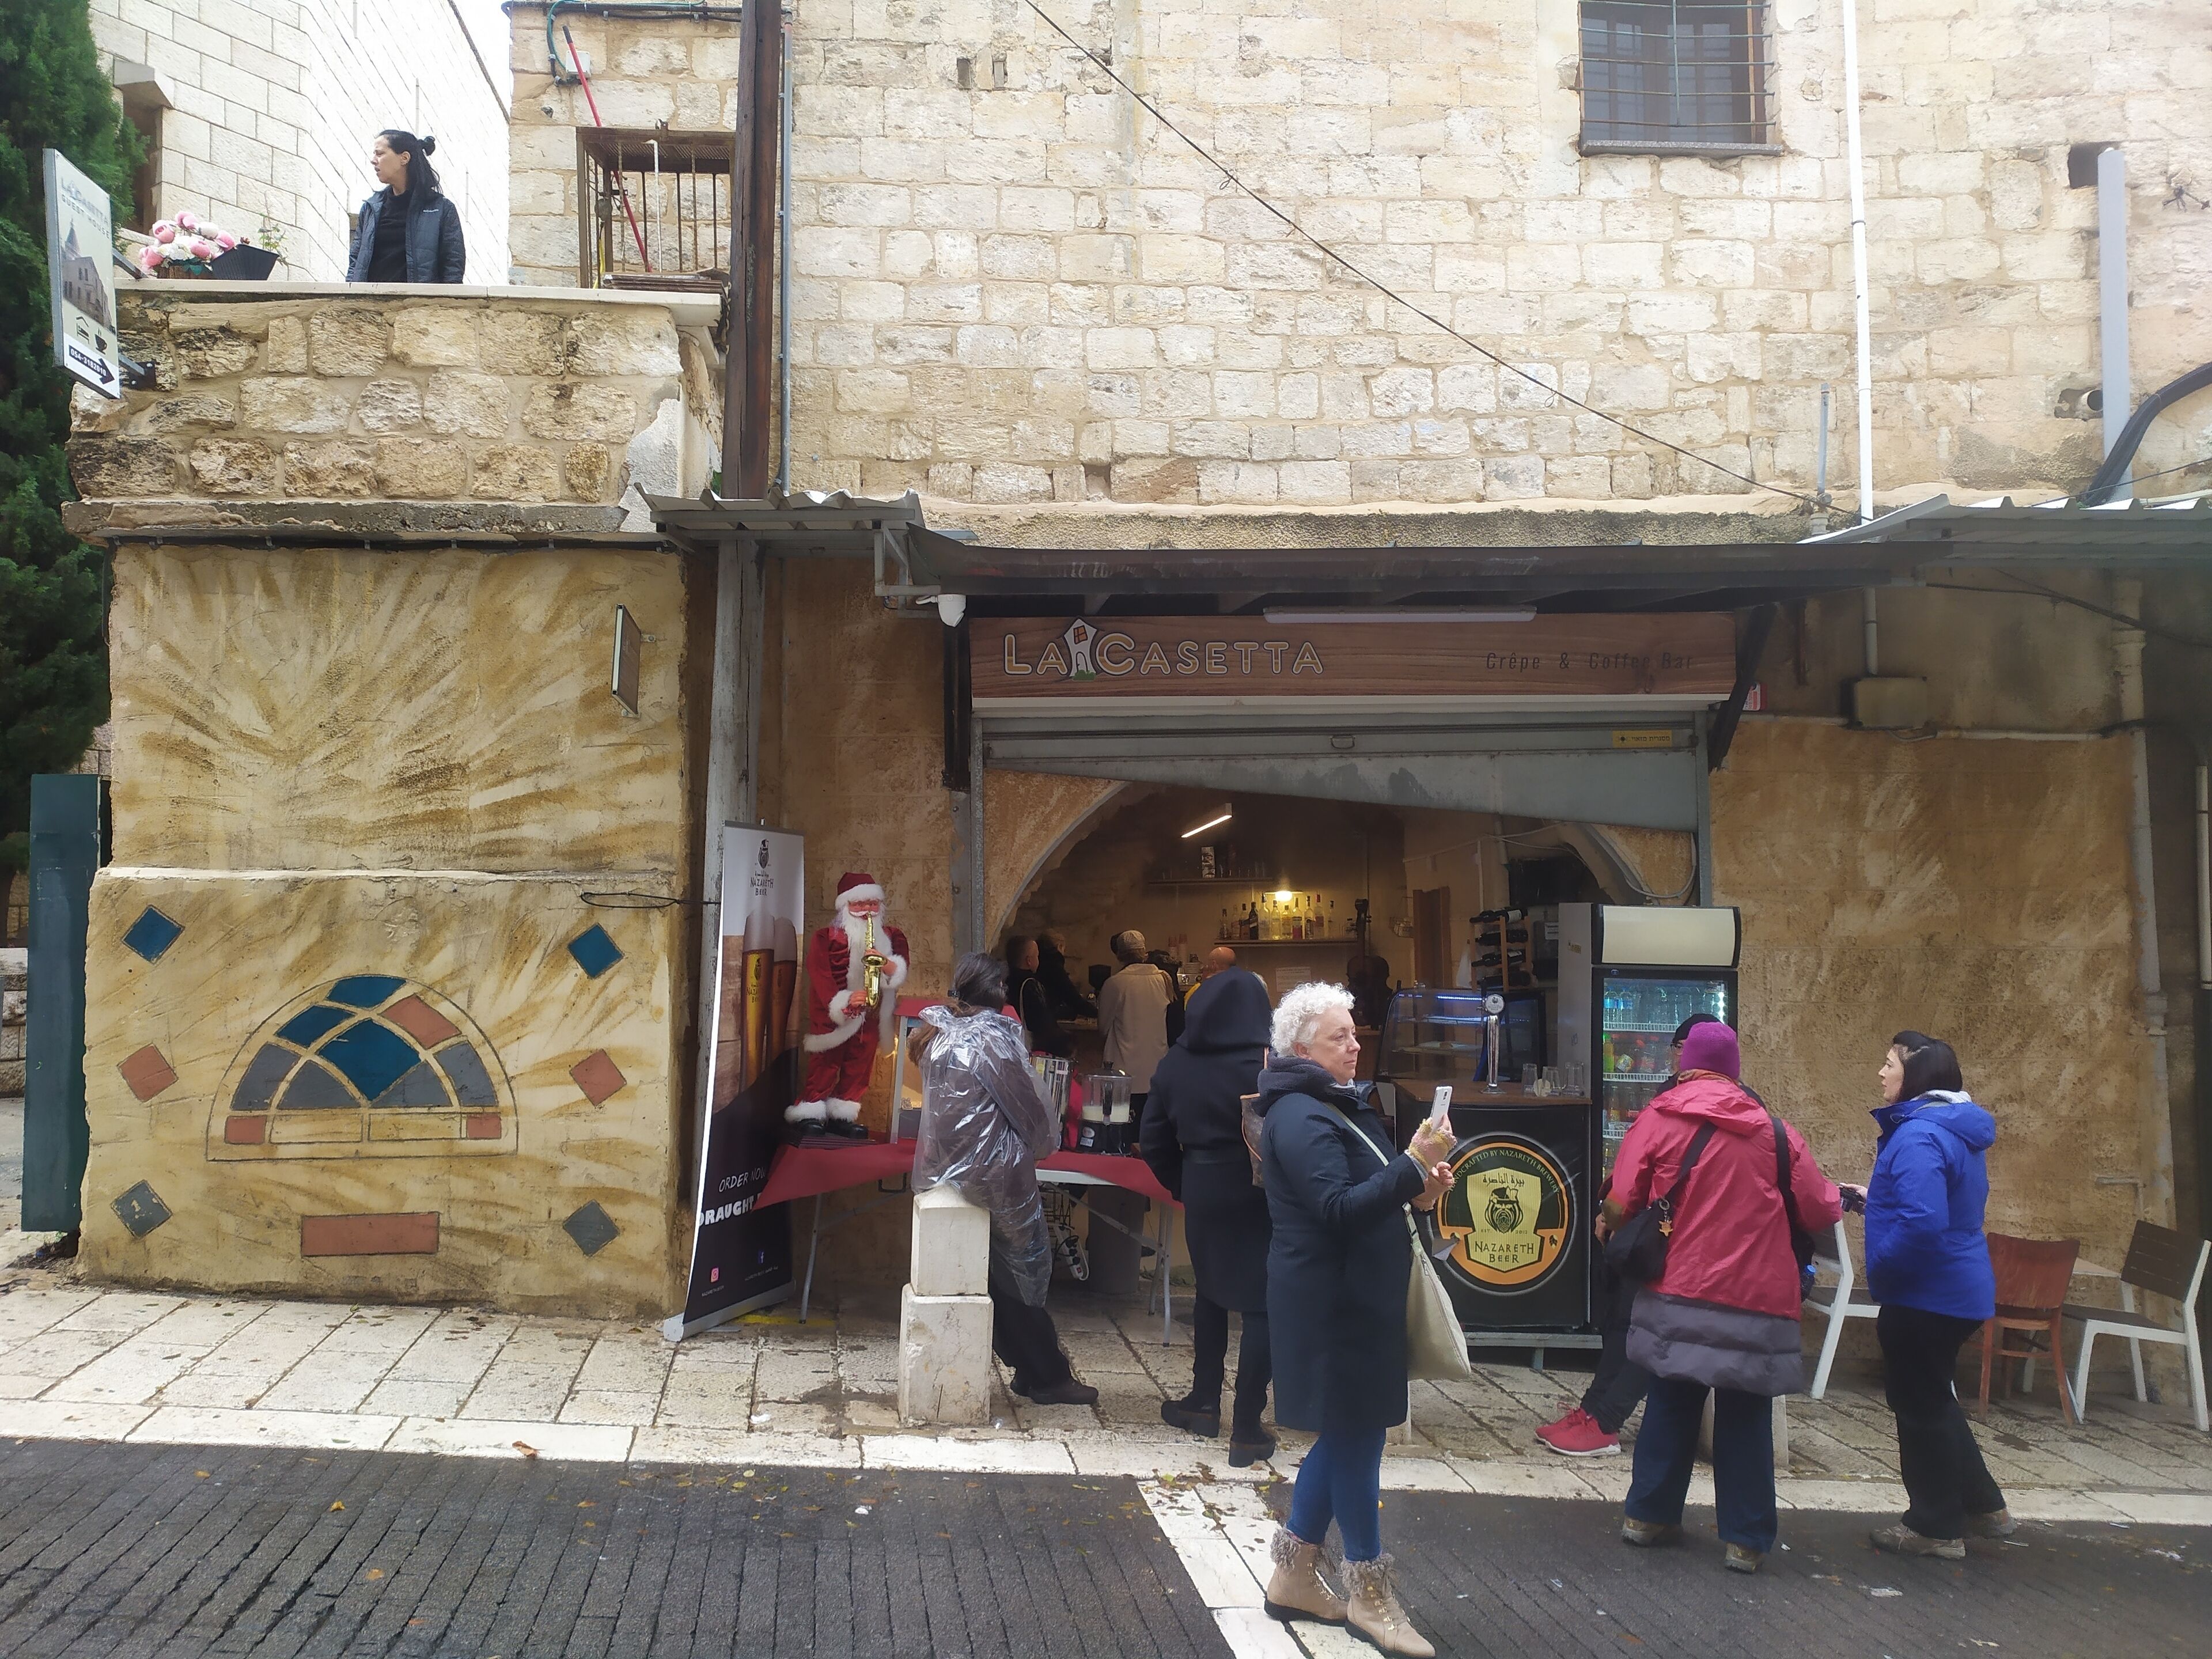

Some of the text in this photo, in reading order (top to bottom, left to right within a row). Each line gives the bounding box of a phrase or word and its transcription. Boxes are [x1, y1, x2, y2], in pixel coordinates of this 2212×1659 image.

[62, 194, 109, 239] GUEST HOUSE
[70, 349, 107, 377] 054-3182010
[1003, 632, 1324, 676] LA CASETTA
[1486, 652, 1694, 673] Crêpe & Coffee Bar
[750, 877, 774, 888] NAZARETH
[755, 888, 767, 896] BEER
[719, 1172, 749, 1192] ORDER
[1499, 1150, 1536, 1167] NAZARETH
[1536, 1164, 1560, 1194] BREWERY
[1510, 1175, 1525, 1188] بيرة
[1475, 1241, 1534, 1254] NAZARETH
[1488, 1253, 1520, 1263] BEER
